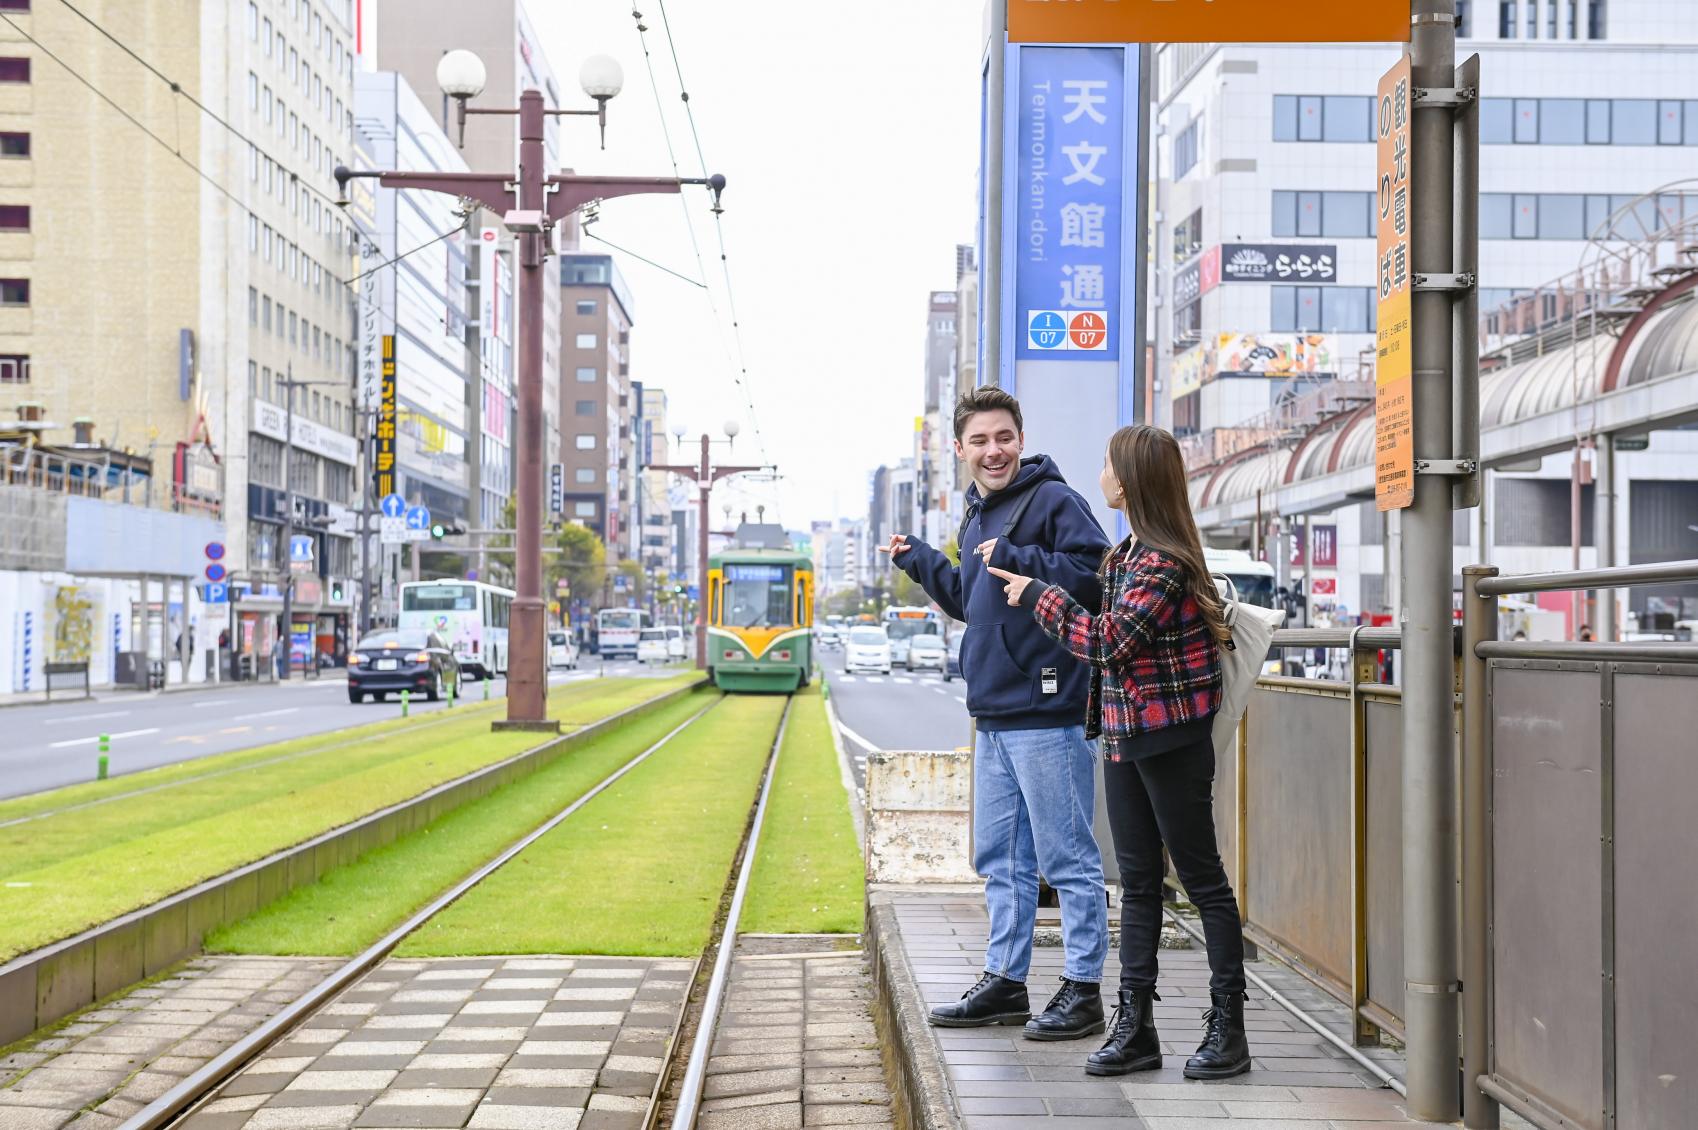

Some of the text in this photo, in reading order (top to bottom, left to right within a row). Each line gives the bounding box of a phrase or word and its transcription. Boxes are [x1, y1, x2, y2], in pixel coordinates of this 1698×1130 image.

[1030, 79, 1051, 262] Tenmonkan-dori
[1394, 76, 1407, 291] 観光電車
[1060, 79, 1109, 309] 天文館通
[1380, 94, 1392, 301] のりば
[1045, 314, 1051, 327] I
[1082, 314, 1093, 328] N
[1040, 331, 1057, 344] 07
[1079, 332, 1096, 345] 07
[210, 585, 223, 602] P
